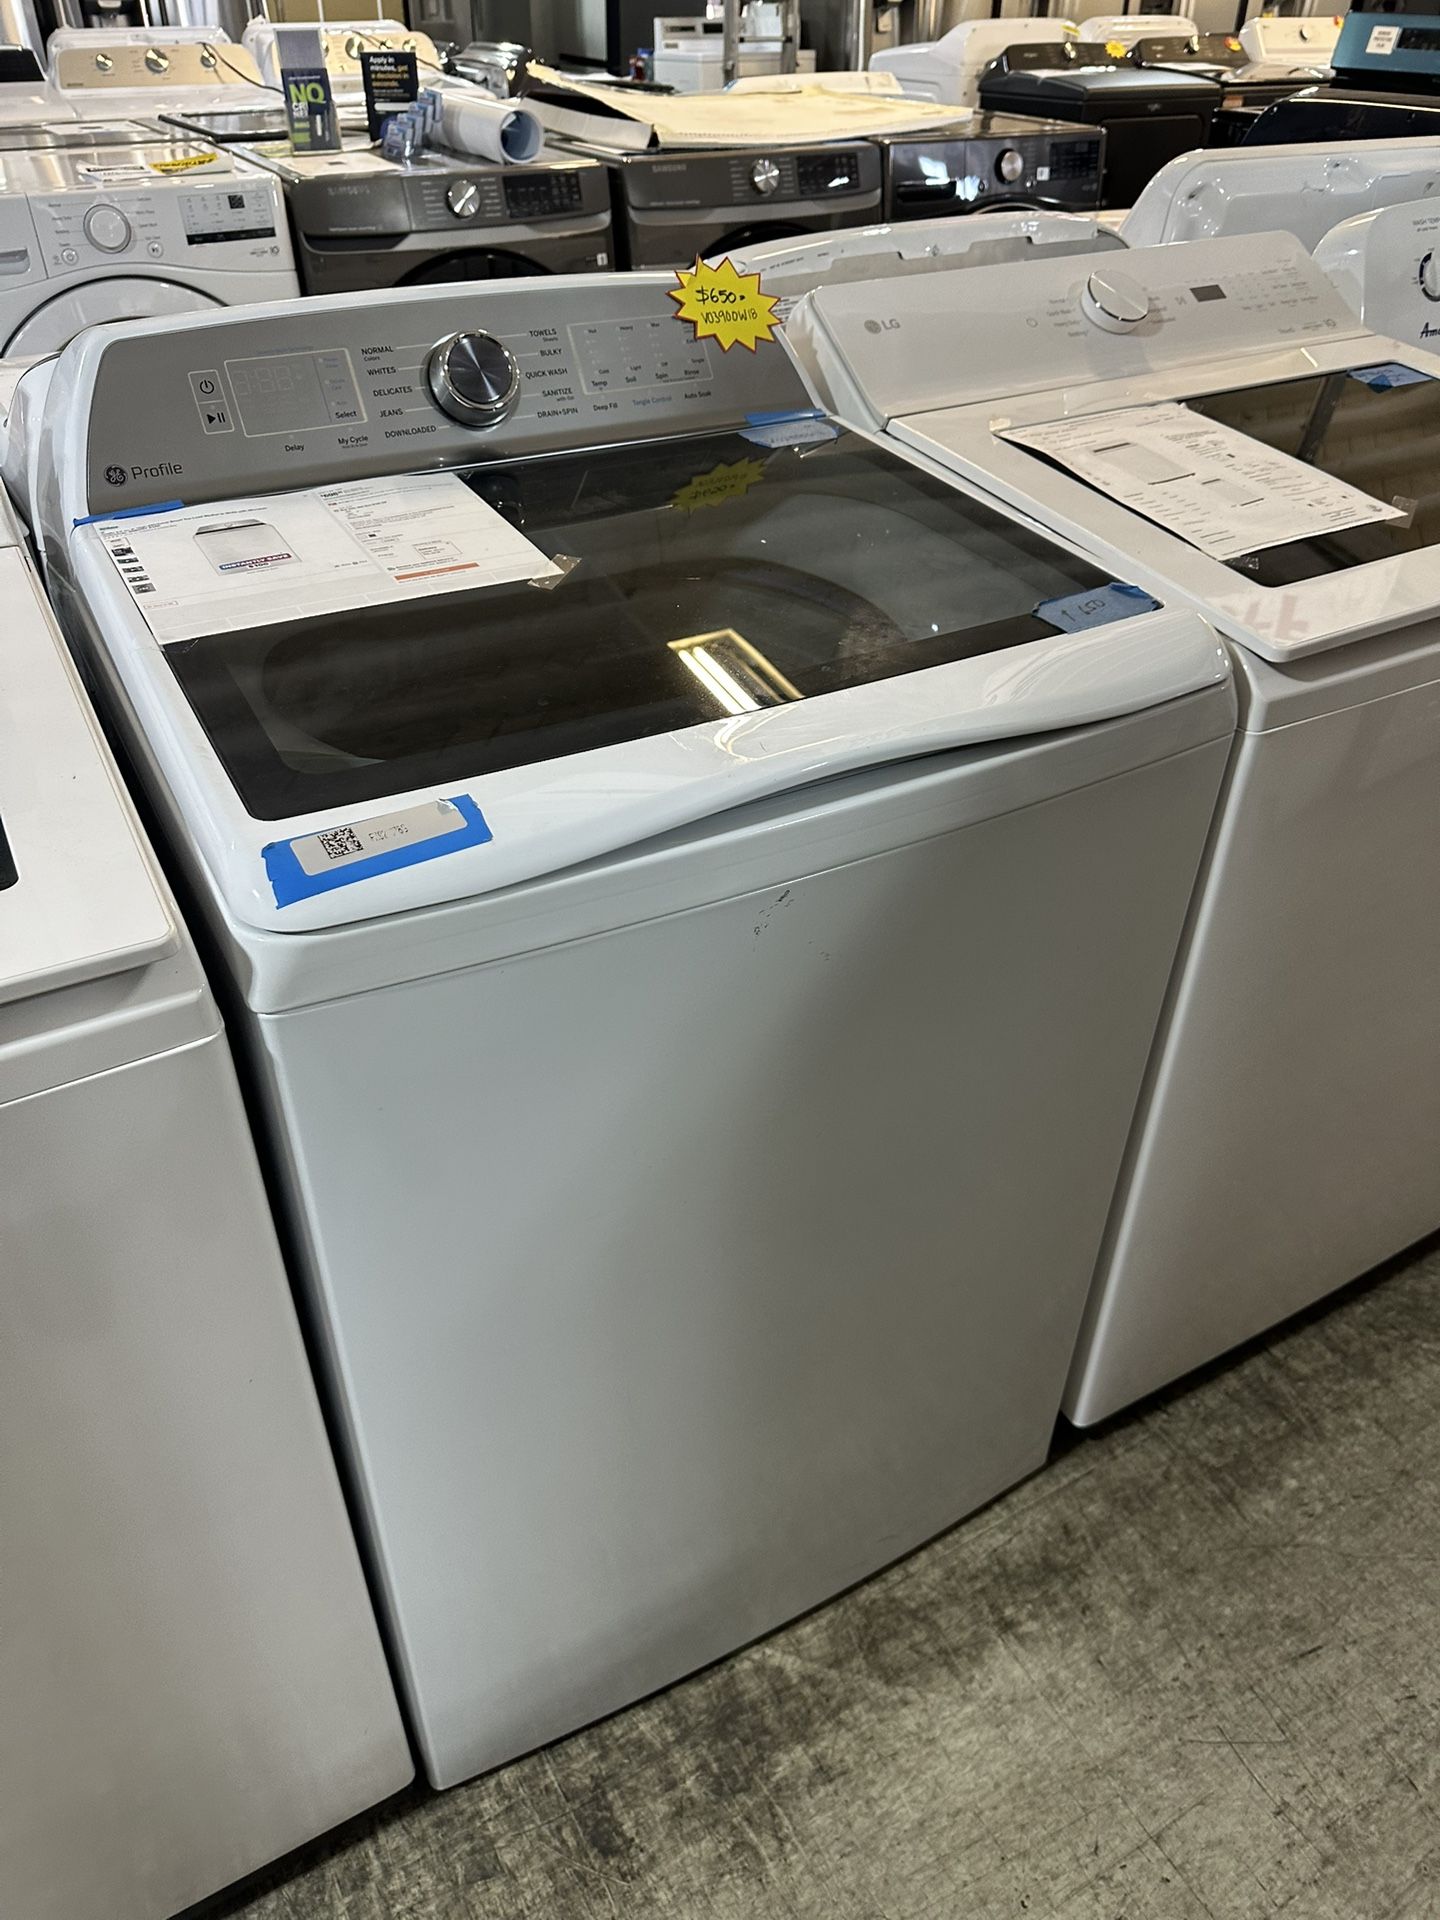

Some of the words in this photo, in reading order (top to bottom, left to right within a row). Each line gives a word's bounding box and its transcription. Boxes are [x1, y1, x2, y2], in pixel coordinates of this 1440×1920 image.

[880, 318, 901, 330] LG
[529, 328, 557, 337] TOWELS
[361, 345, 394, 355] NORMAL
[540, 349, 562, 357] BULKY
[367, 366, 396, 376] WHITES
[525, 370, 546, 379] QUICK
[547, 368, 568, 377] WASH
[592, 380, 608, 388] Temp
[373, 386, 413, 397] DELICATES
[541, 388, 573, 397] SANITIZE
[379, 408, 404, 418] JEANS
[537, 408, 578, 418] DRAIN+SPIN
[593, 404, 609, 412] Deep
[335, 411, 357, 419] Select
[384, 425, 437, 438] DOWNLOADED
[349, 436, 369, 444] Cycle
[285, 444, 304, 452] Delay
[131, 462, 183, 480] Profile
